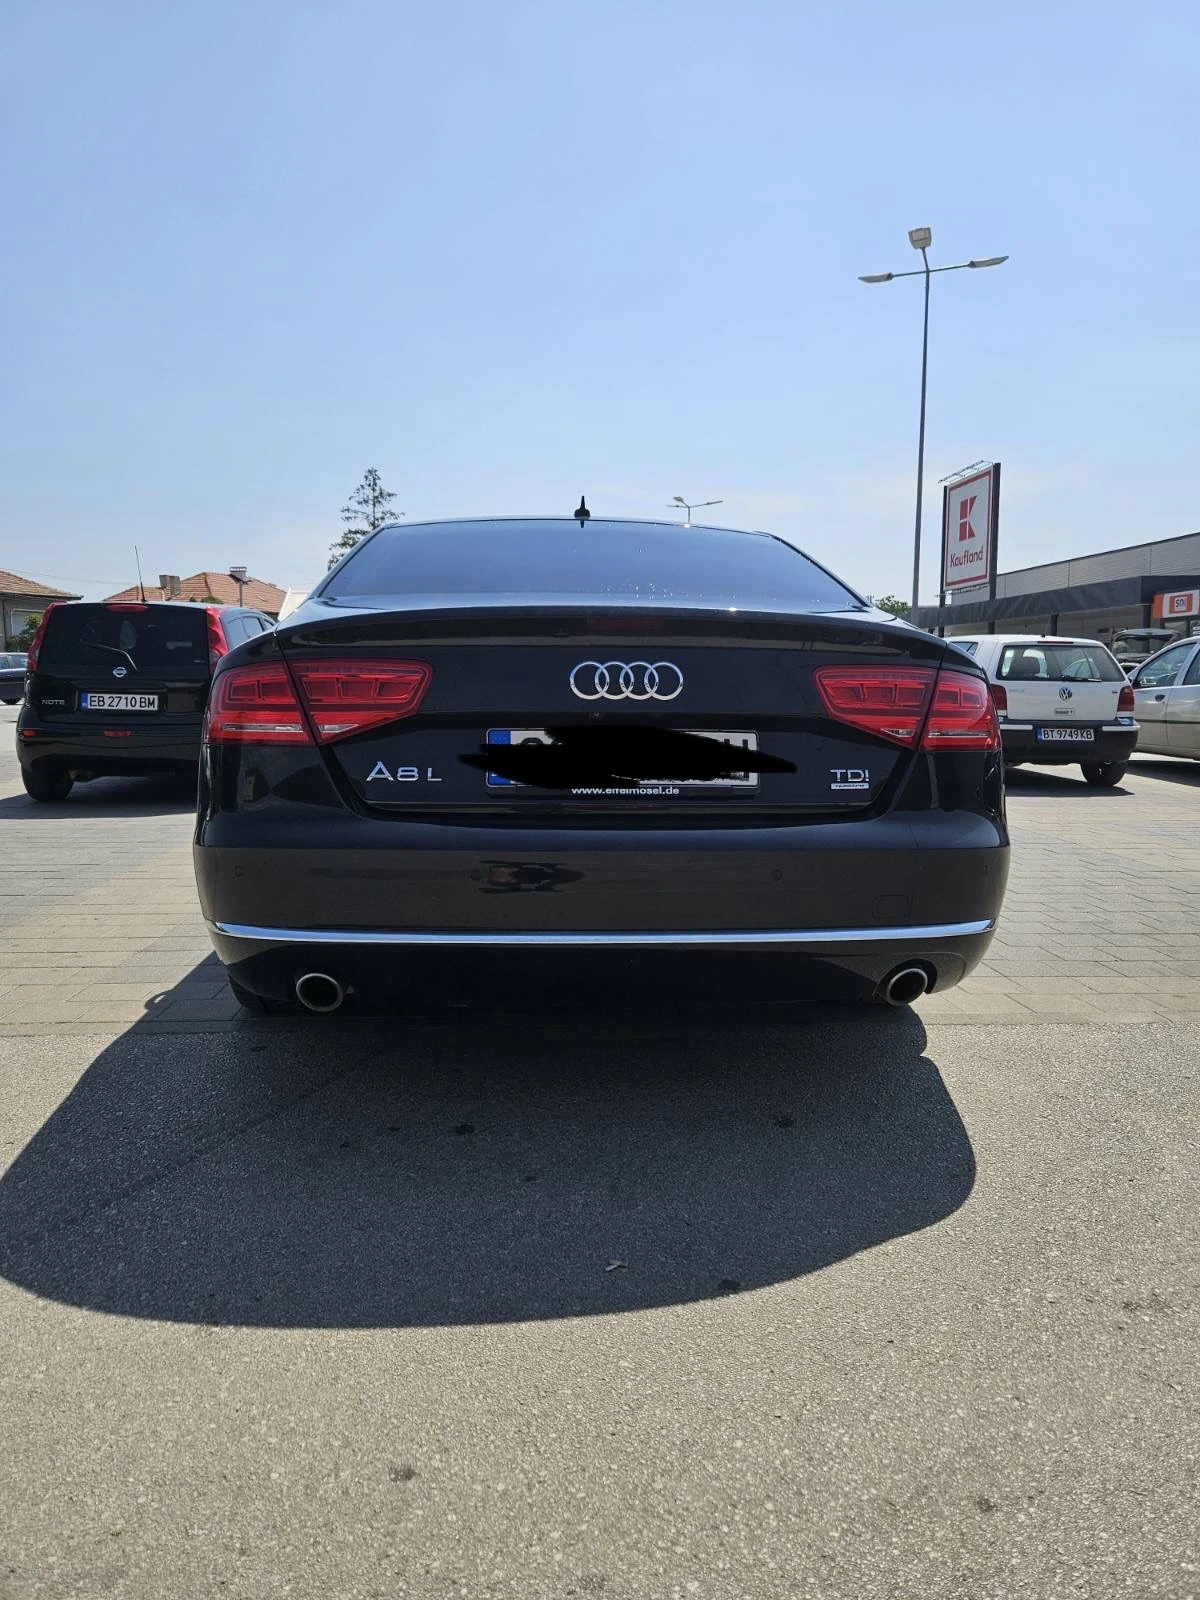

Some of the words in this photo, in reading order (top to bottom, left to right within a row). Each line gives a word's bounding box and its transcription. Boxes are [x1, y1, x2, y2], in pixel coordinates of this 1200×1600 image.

[950, 545, 984, 568] Kaufland
[89, 695, 106, 708] EB
[107, 696, 137, 708] 2710
[139, 697, 156, 709] BM
[366, 761, 419, 781] A8
[427, 767, 442, 781] L
[830, 769, 869, 782] TDI
